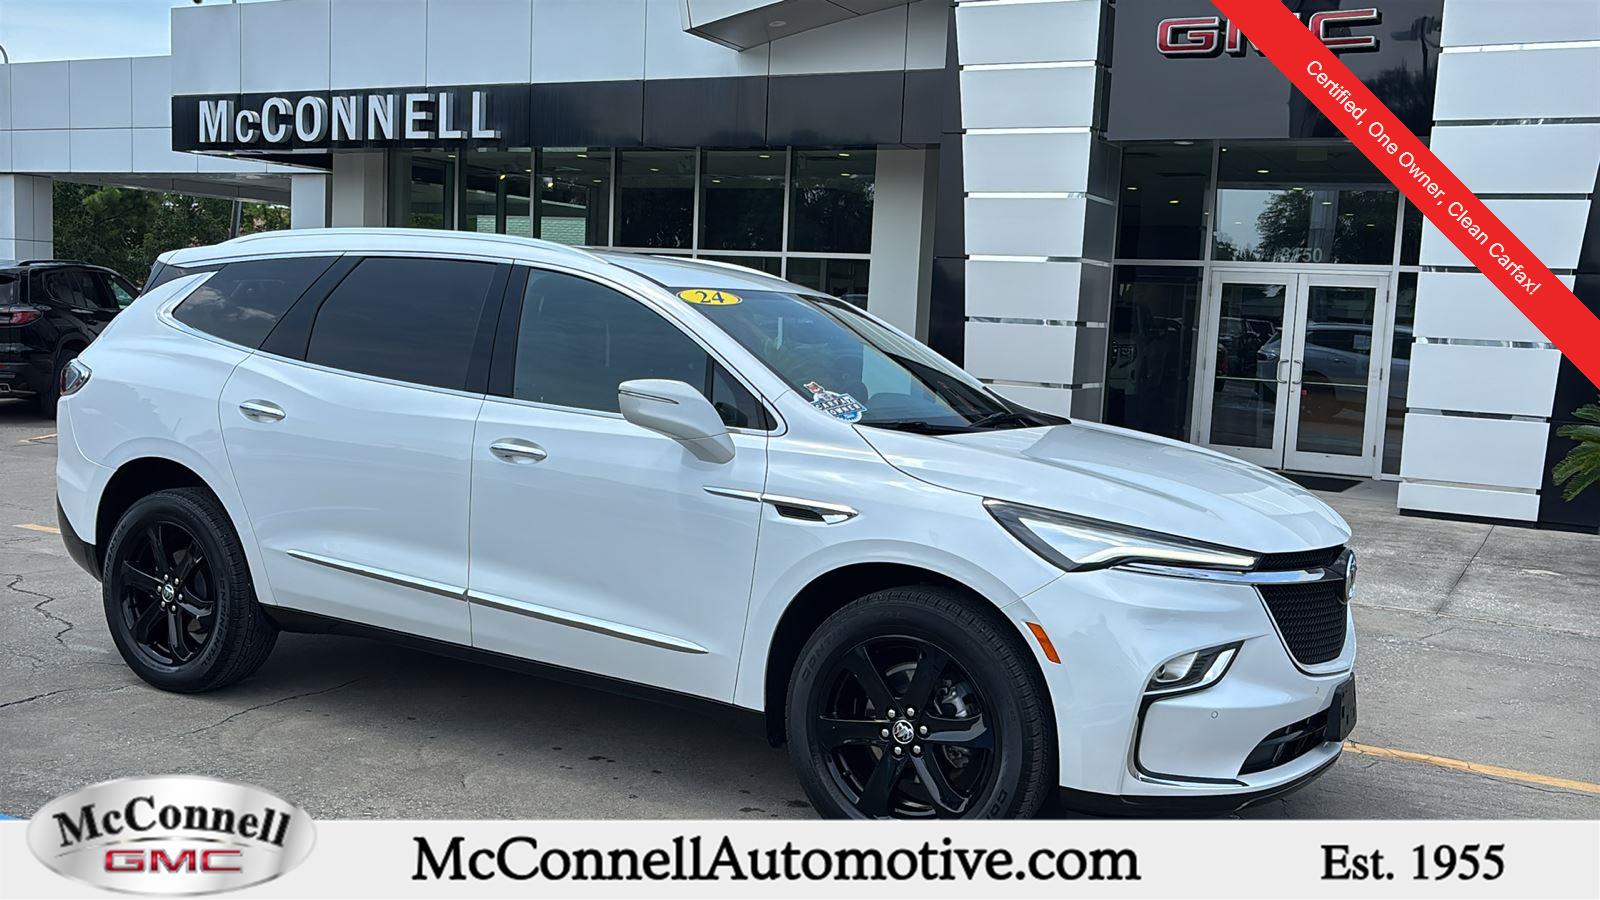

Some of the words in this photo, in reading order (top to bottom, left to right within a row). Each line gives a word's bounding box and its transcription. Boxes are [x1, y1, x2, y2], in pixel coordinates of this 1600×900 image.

[1157, 8, 1382, 57] GC
[199, 91, 501, 144] McCONNELL
[695, 290, 725, 304] 24
